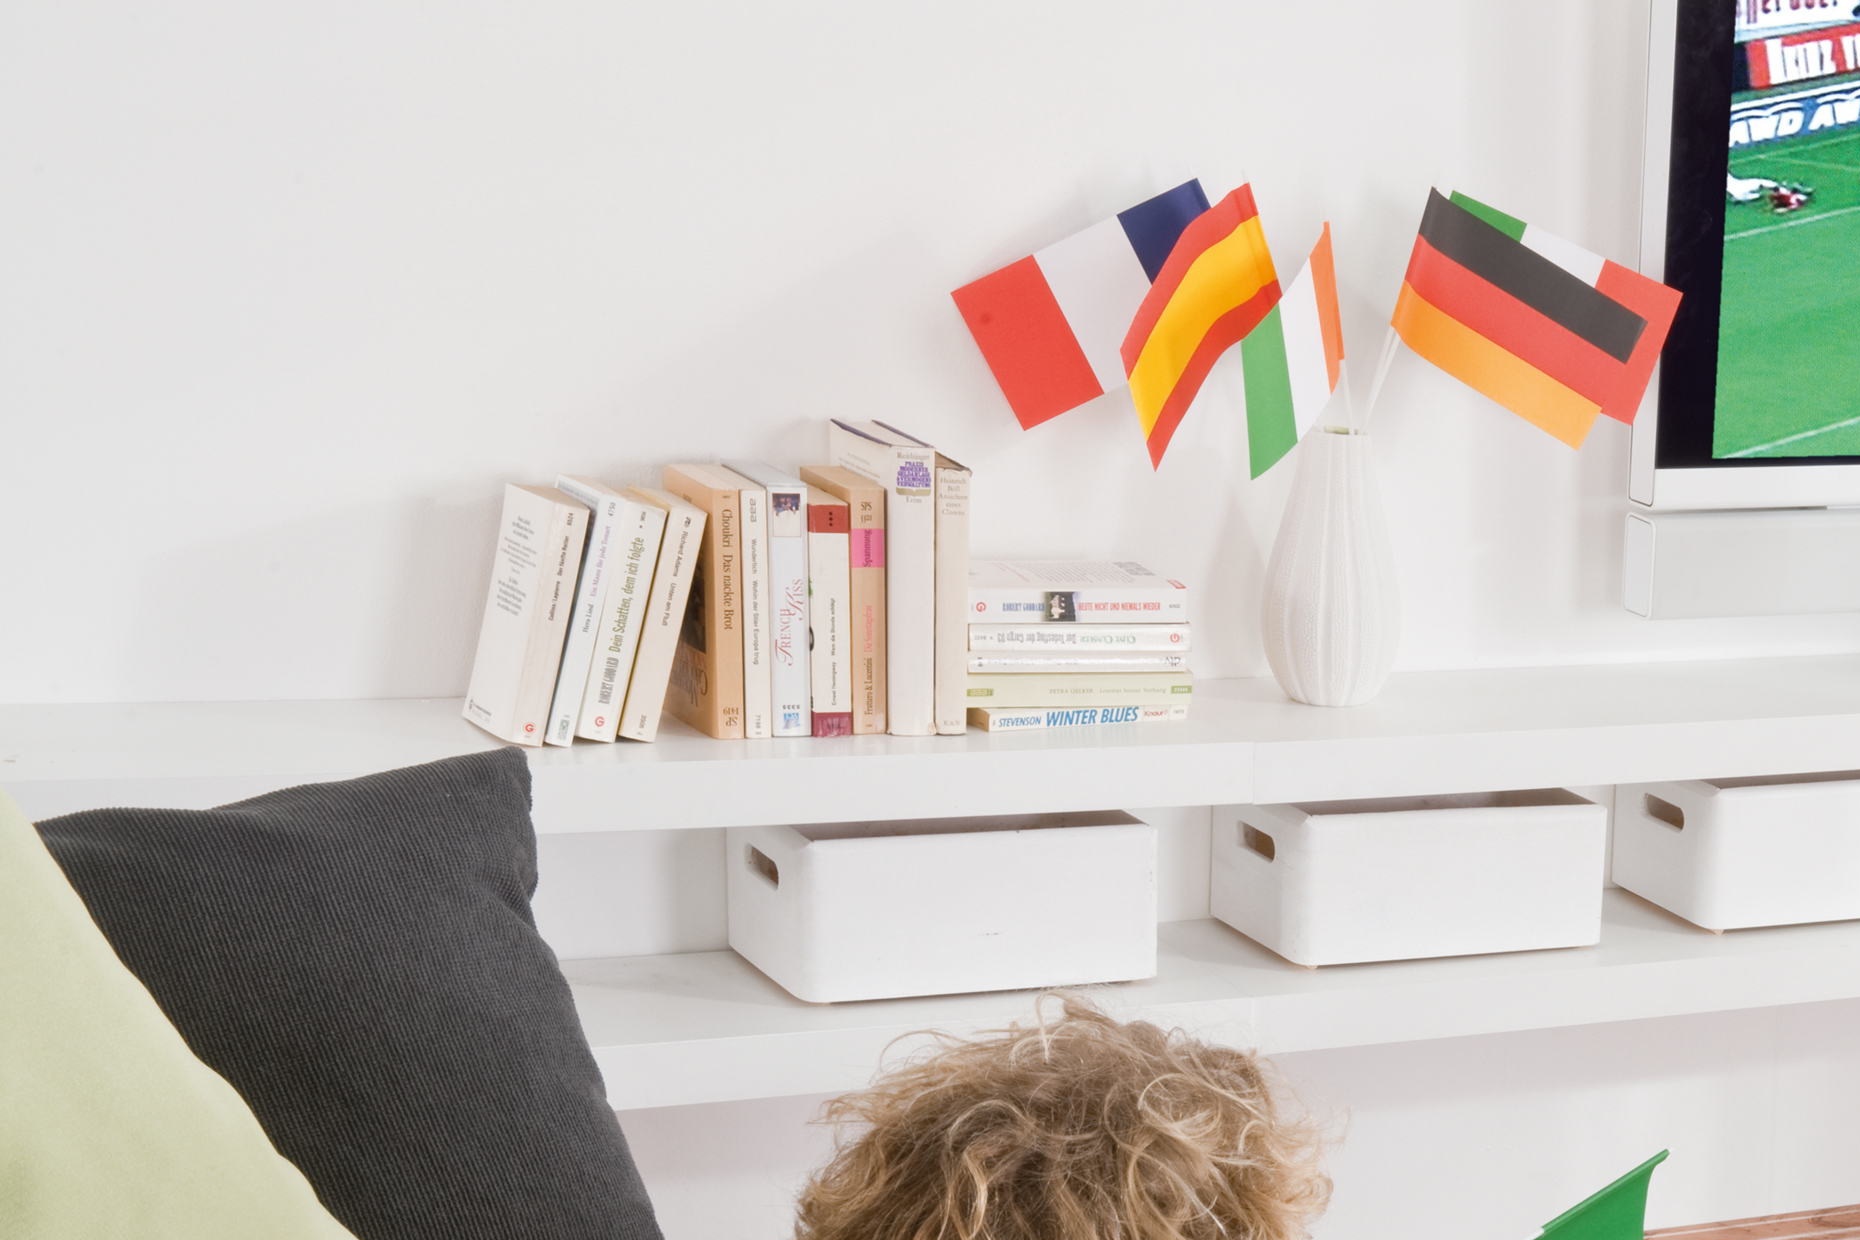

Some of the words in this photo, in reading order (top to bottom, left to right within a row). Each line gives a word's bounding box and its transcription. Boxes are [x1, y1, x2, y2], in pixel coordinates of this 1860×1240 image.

[1729, 110, 1804, 147] AWD
[896, 452, 930, 460] Reithinger
[602, 526, 611, 545] Tonart
[722, 509, 733, 548] Choukri
[598, 544, 606, 560] jede
[628, 537, 645, 563] folgte
[678, 530, 689, 556] Richard
[863, 530, 873, 567] Spannung
[624, 562, 639, 577] ich
[673, 555, 682, 577] Adams
[723, 554, 733, 573] Das
[593, 571, 601, 588] Mann
[621, 575, 636, 595] dem
[590, 587, 598, 597] Ein
[667, 582, 677, 602] Unten
[723, 575, 734, 607] nackte
[586, 604, 594, 618] Lind
[612, 596, 632, 634] Schatten,
[1002, 603, 1022, 612] ROBERT
[1078, 602, 1093, 611] HEUTE
[1095, 602, 1109, 611] NICHT
[1110, 602, 1120, 611] UND
[1121, 602, 1142, 611] NIEMALS
[1143, 602, 1161, 611] WIEDER
[582, 617, 591, 633] Hera
[724, 609, 734, 630] Brot
[608, 635, 623, 653] Dein
[998, 716, 1042, 728] STEVENSON
[1046, 710, 1098, 727] WINTER
[1101, 706, 1139, 724] BLUES
